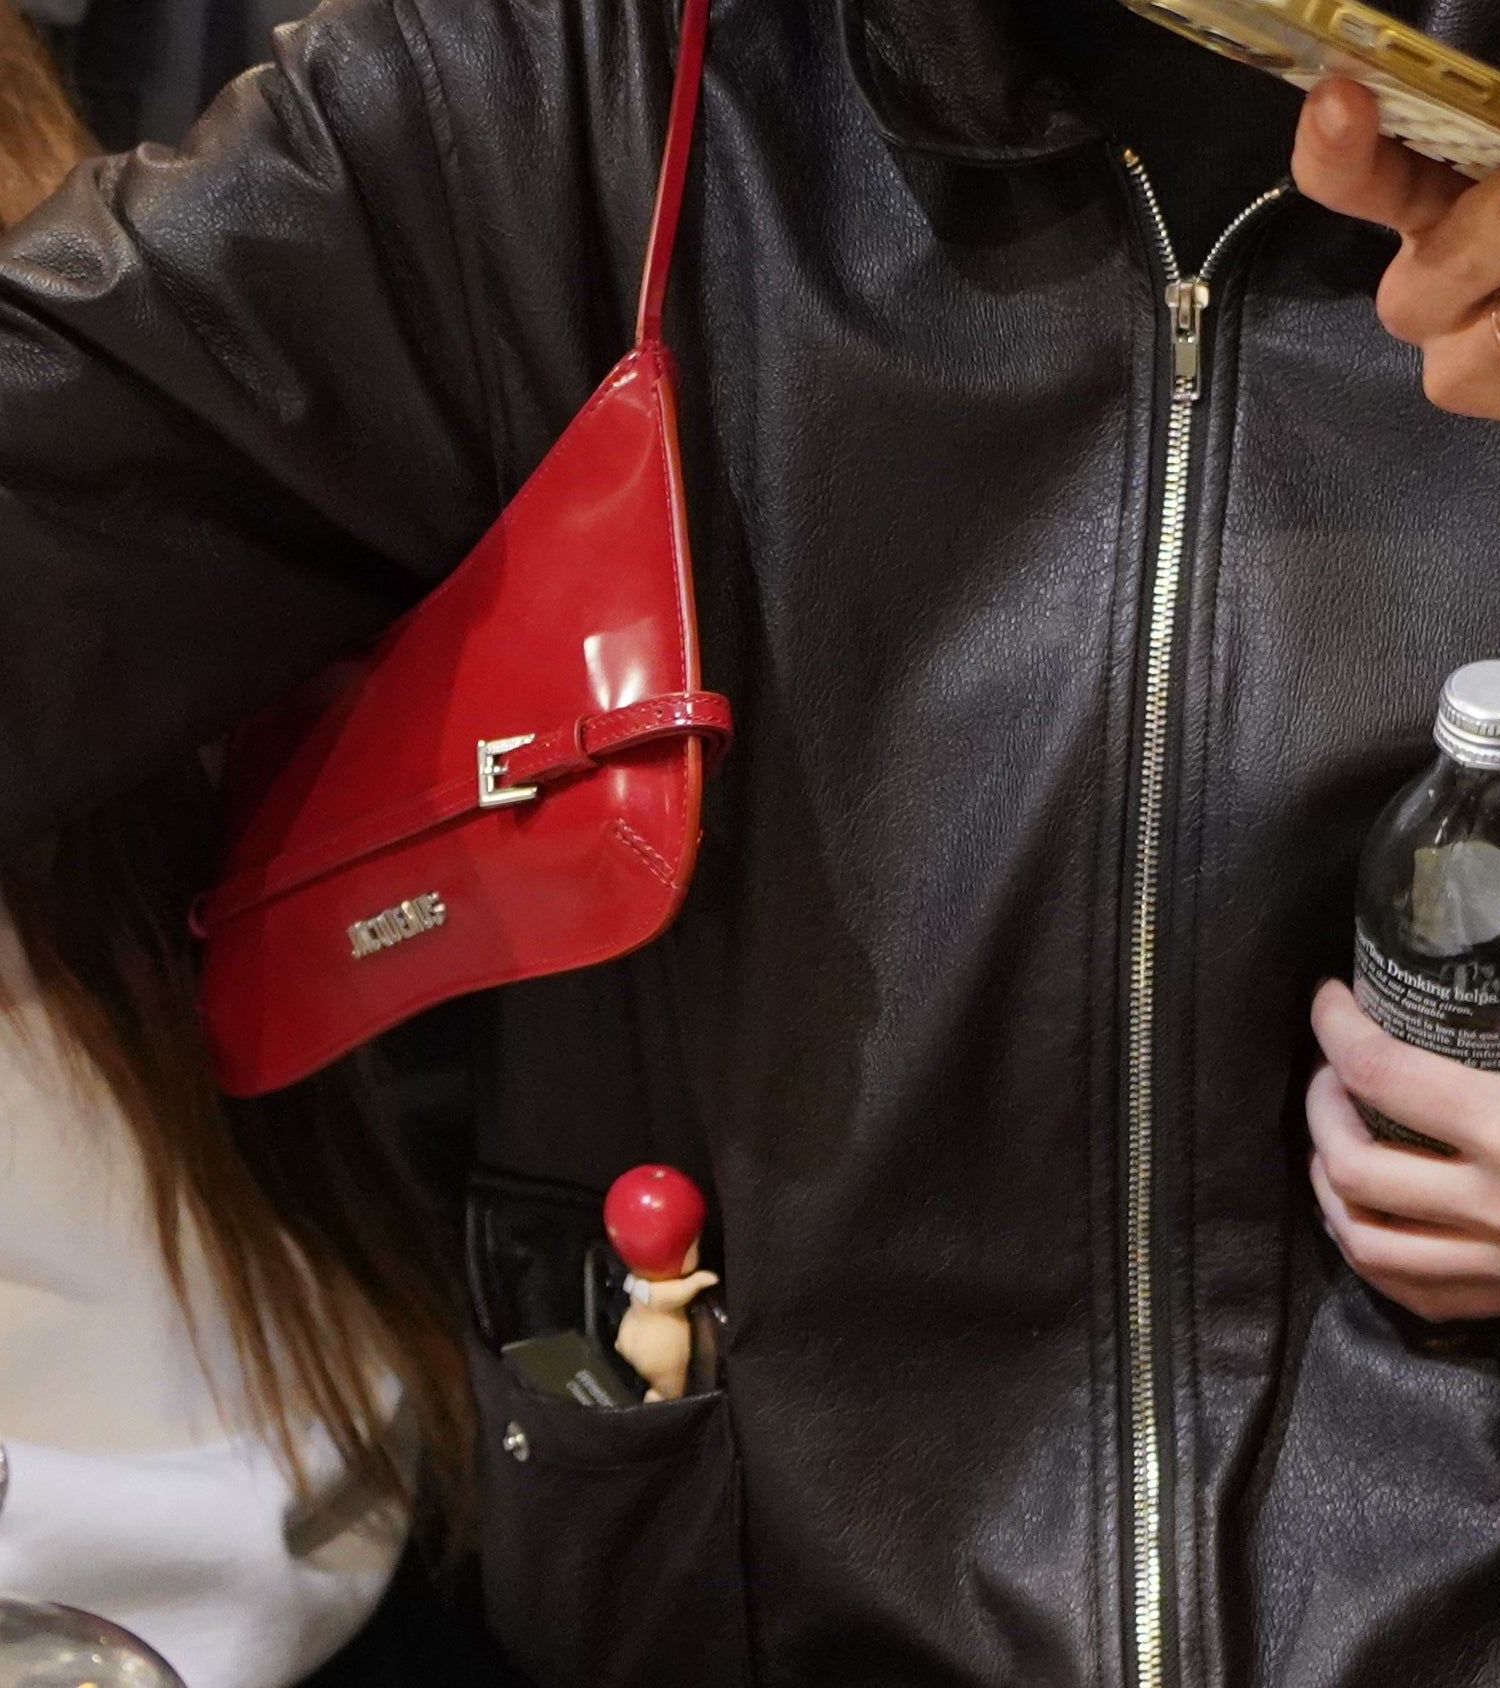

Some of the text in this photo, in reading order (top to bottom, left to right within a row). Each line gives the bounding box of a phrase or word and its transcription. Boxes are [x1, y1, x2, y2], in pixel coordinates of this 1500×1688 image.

[1387, 958, 1450, 1001] Drinking
[1406, 988, 1422, 1003] bio
[1458, 1028, 1476, 1040] thé
